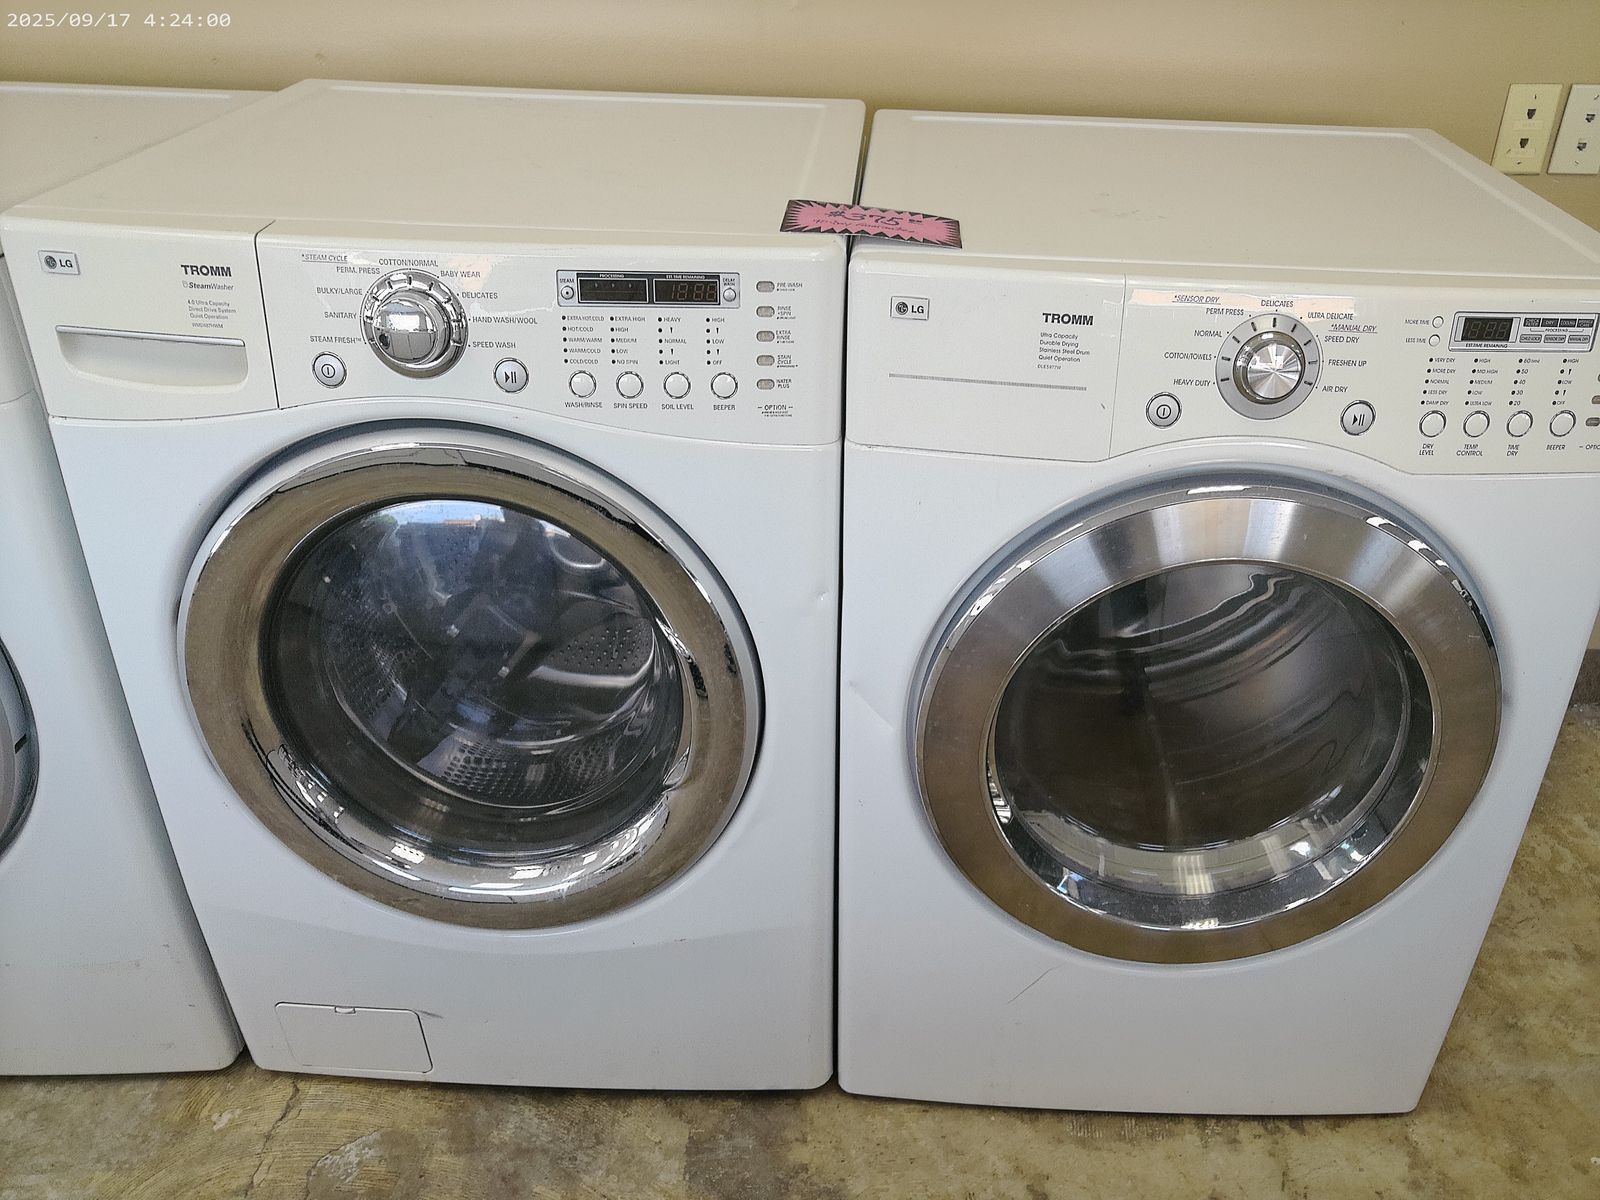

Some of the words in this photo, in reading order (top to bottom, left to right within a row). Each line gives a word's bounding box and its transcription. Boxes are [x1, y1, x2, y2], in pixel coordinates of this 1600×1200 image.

[328, 254, 348, 262] CYCLE
[378, 258, 439, 267] COTTON/NORMAL
[59, 259, 73, 269] LG
[181, 264, 232, 277] TROMM
[358, 267, 381, 275] PRESS
[440, 270, 459, 278] BABY
[459, 271, 481, 279] WEAR
[188, 282, 234, 291] SteamWasher
[316, 287, 363, 296] BULKY/LARGE
[461, 291, 499, 300] DELICATES
[1205, 296, 1220, 304] DRY
[1260, 299, 1294, 308] DELICATES
[911, 305, 925, 314] LG
[1226, 308, 1244, 317] PRESS
[324, 312, 357, 320] SANITARY
[472, 316, 493, 324] HAND
[493, 316, 538, 325] WASH/WOOL
[1042, 312, 1094, 326] TROMM
[1307, 312, 1325, 320] ULTRA
[1326, 312, 1354, 321] DELICATE
[1360, 325, 1377, 333] DRY
[1053, 332, 1079, 340] Capacity
[1194, 330, 1223, 338] NORMAL
[309, 336, 333, 344] STEAM
[1324, 335, 1343, 344] SPEED
[1344, 336, 1360, 344] DRY
[472, 341, 493, 349] SPEED
[494, 341, 516, 349] WASH
[1053, 355, 1081, 363] Operation
[1164, 351, 1212, 361] COTTON/TOWELS
[1328, 359, 1357, 367] FRESHEN
[1173, 379, 1194, 387] HEAVY
[1194, 379, 1211, 387] DUTY
[1321, 385, 1334, 393] AIR
[1334, 386, 1348, 394] DRY
[564, 401, 603, 409] WASH/RINSE
